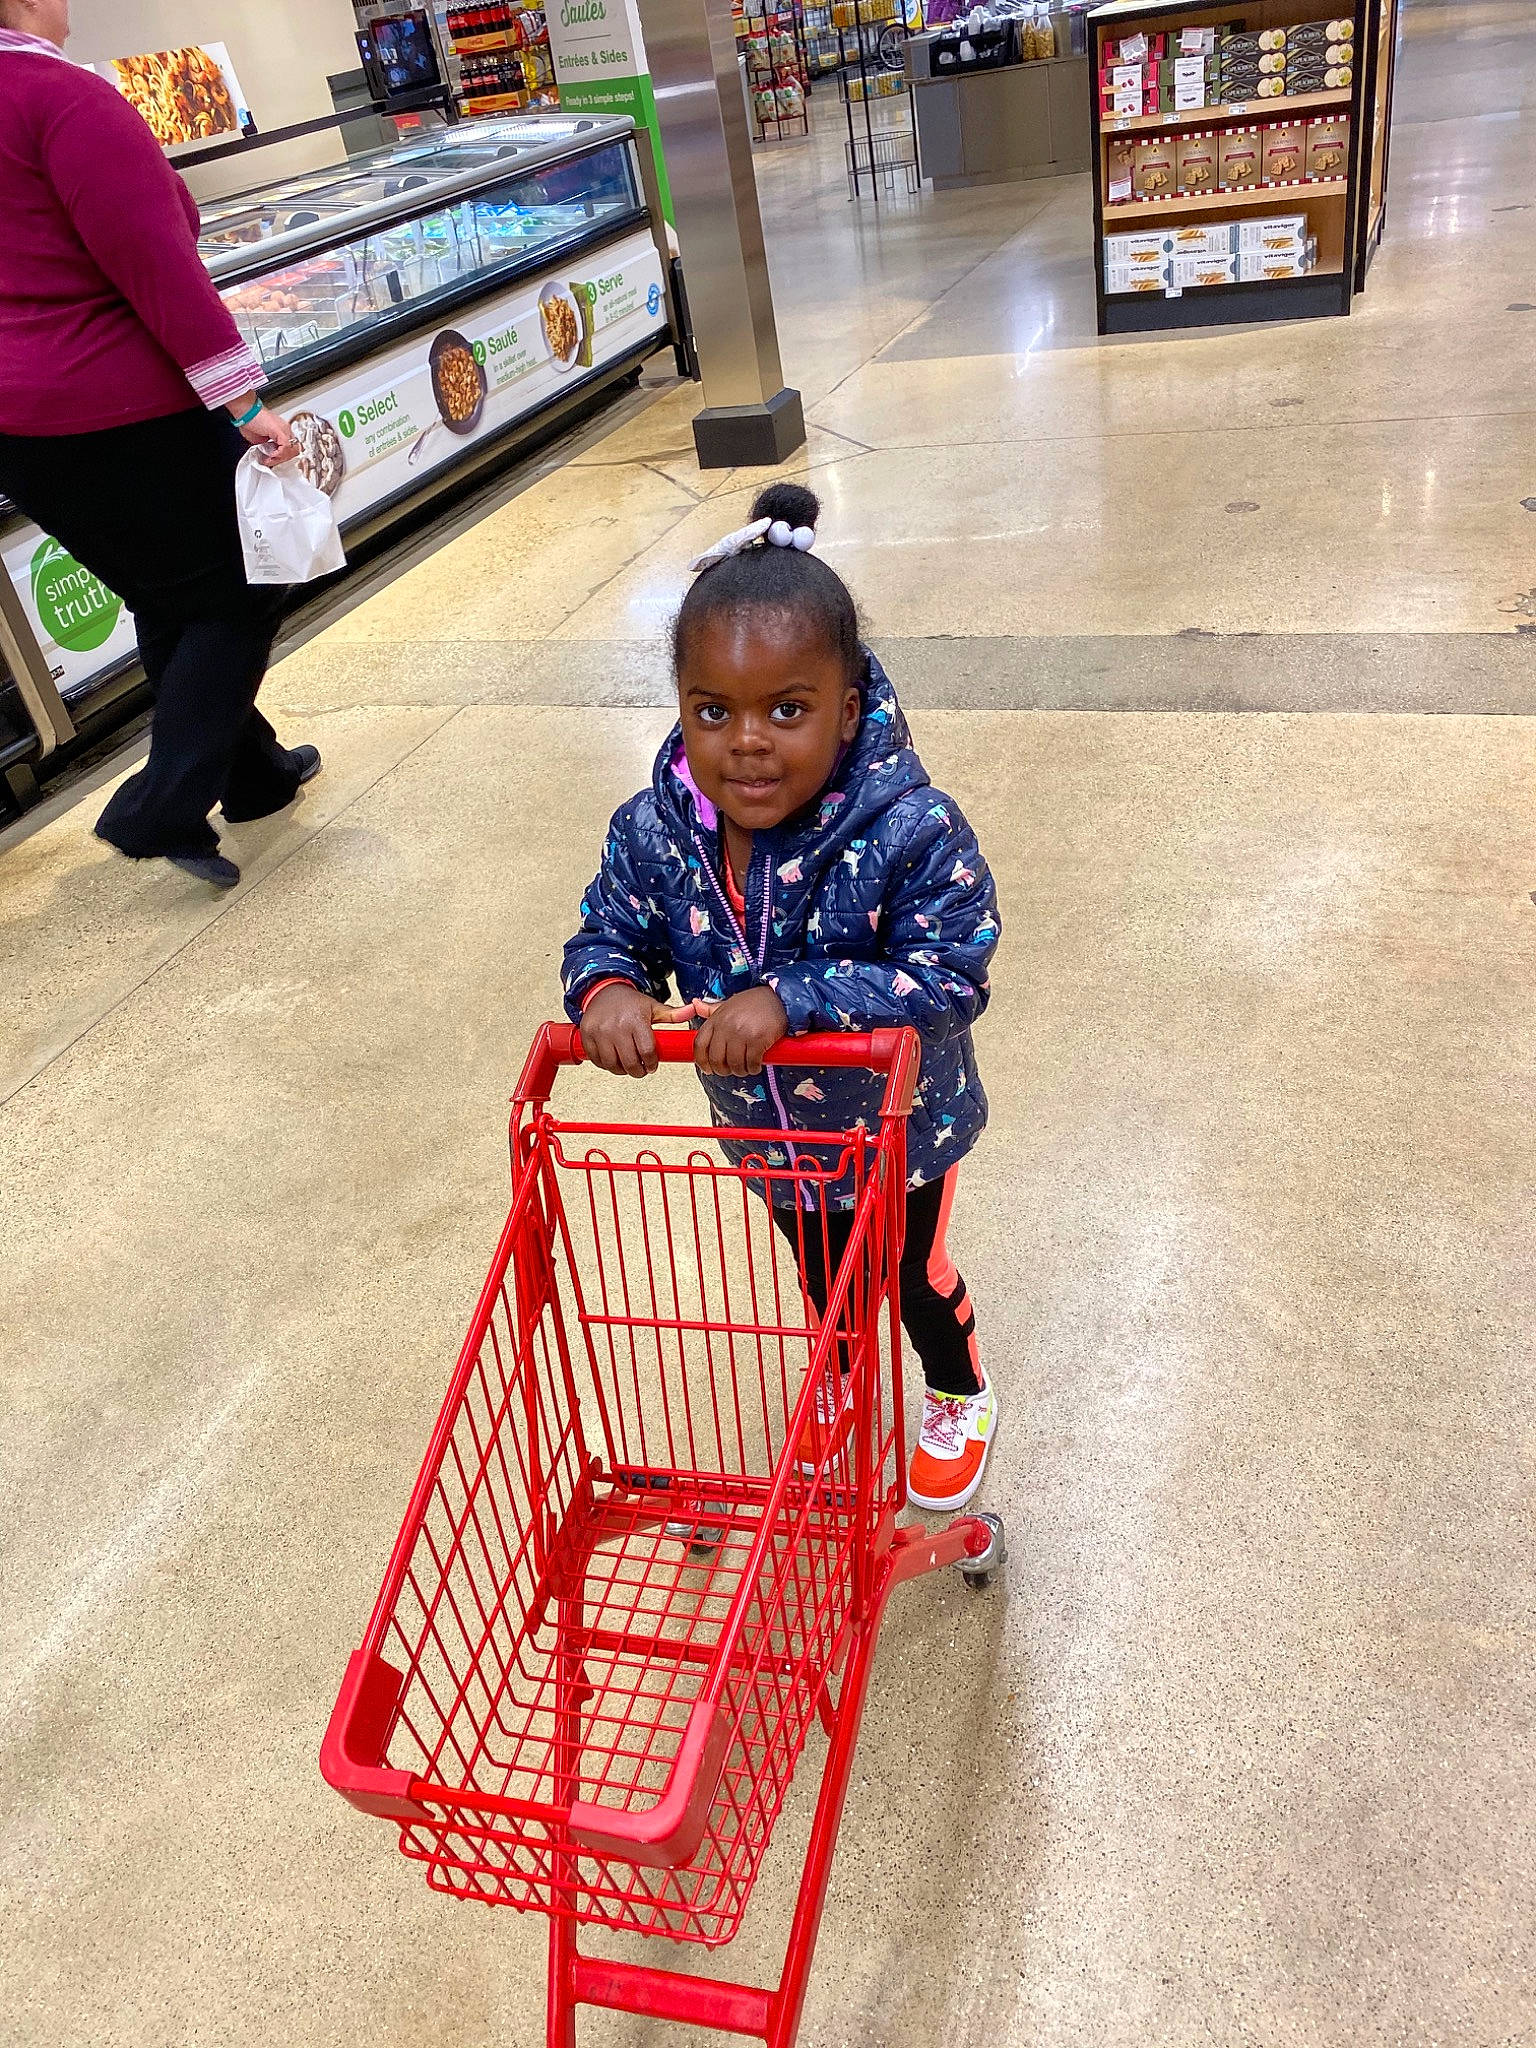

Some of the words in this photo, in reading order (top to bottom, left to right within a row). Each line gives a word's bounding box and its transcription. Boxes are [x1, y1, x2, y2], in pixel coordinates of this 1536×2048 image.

[559, 53, 589, 68] Entrées
[591, 51, 599, 65] &
[600, 49, 628, 64] Sides
[594, 93, 614, 105] simple
[598, 273, 624, 296] Serve
[488, 325, 518, 355] Sauté
[357, 390, 398, 426] Select
[376, 414, 410, 438] combination
